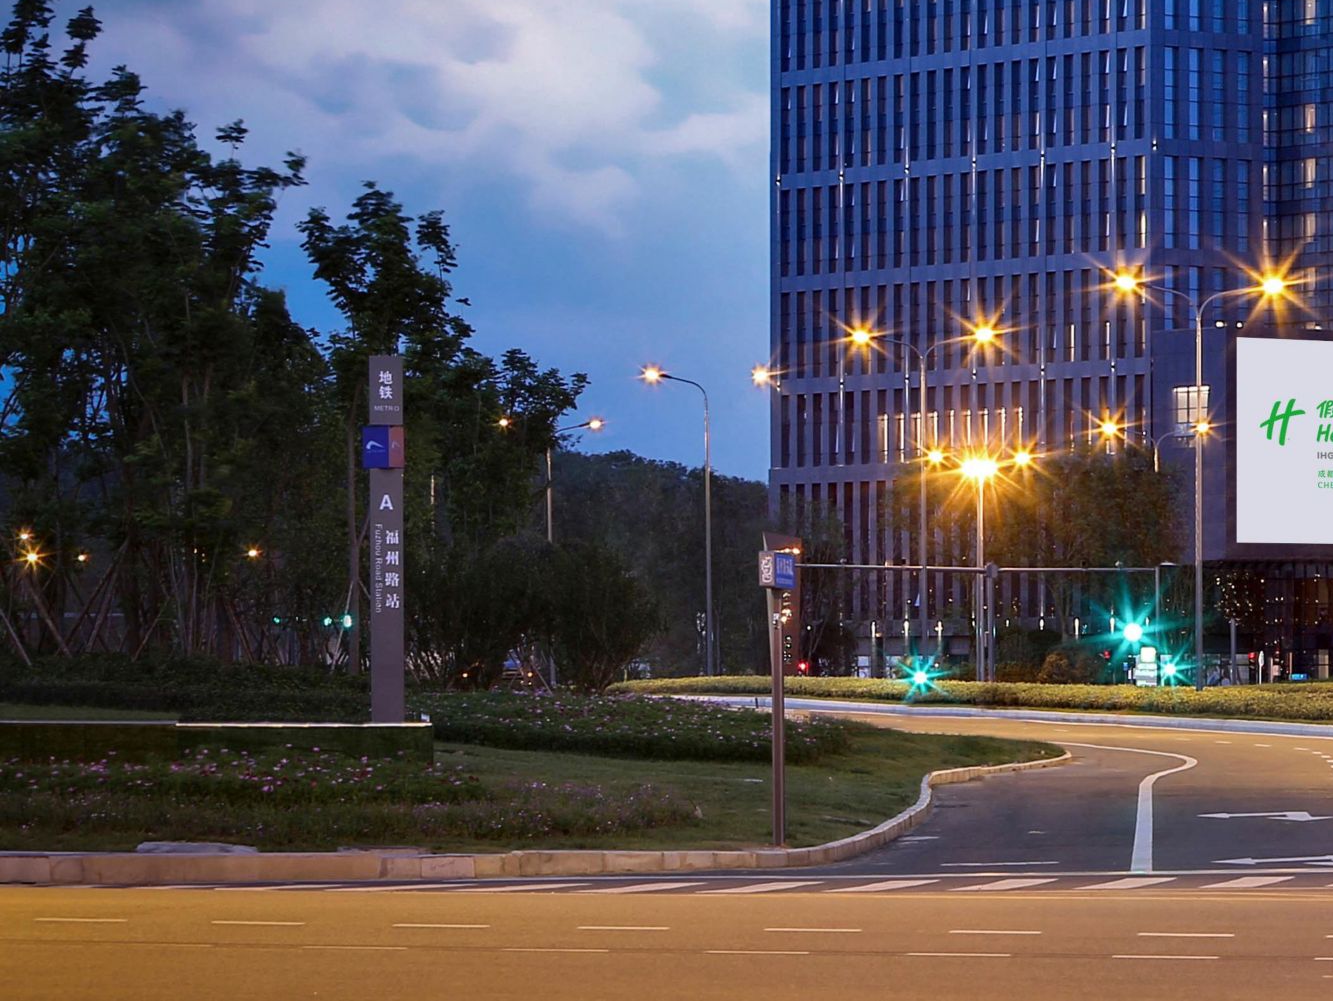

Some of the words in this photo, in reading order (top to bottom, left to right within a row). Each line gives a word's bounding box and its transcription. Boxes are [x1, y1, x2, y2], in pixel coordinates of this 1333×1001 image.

[379, 371, 393, 399] 地铁
[379, 494, 394, 510] A
[375, 524, 383, 556] Fuzhou
[375, 557, 383, 581] Road
[385, 530, 400, 608] 福州路站
